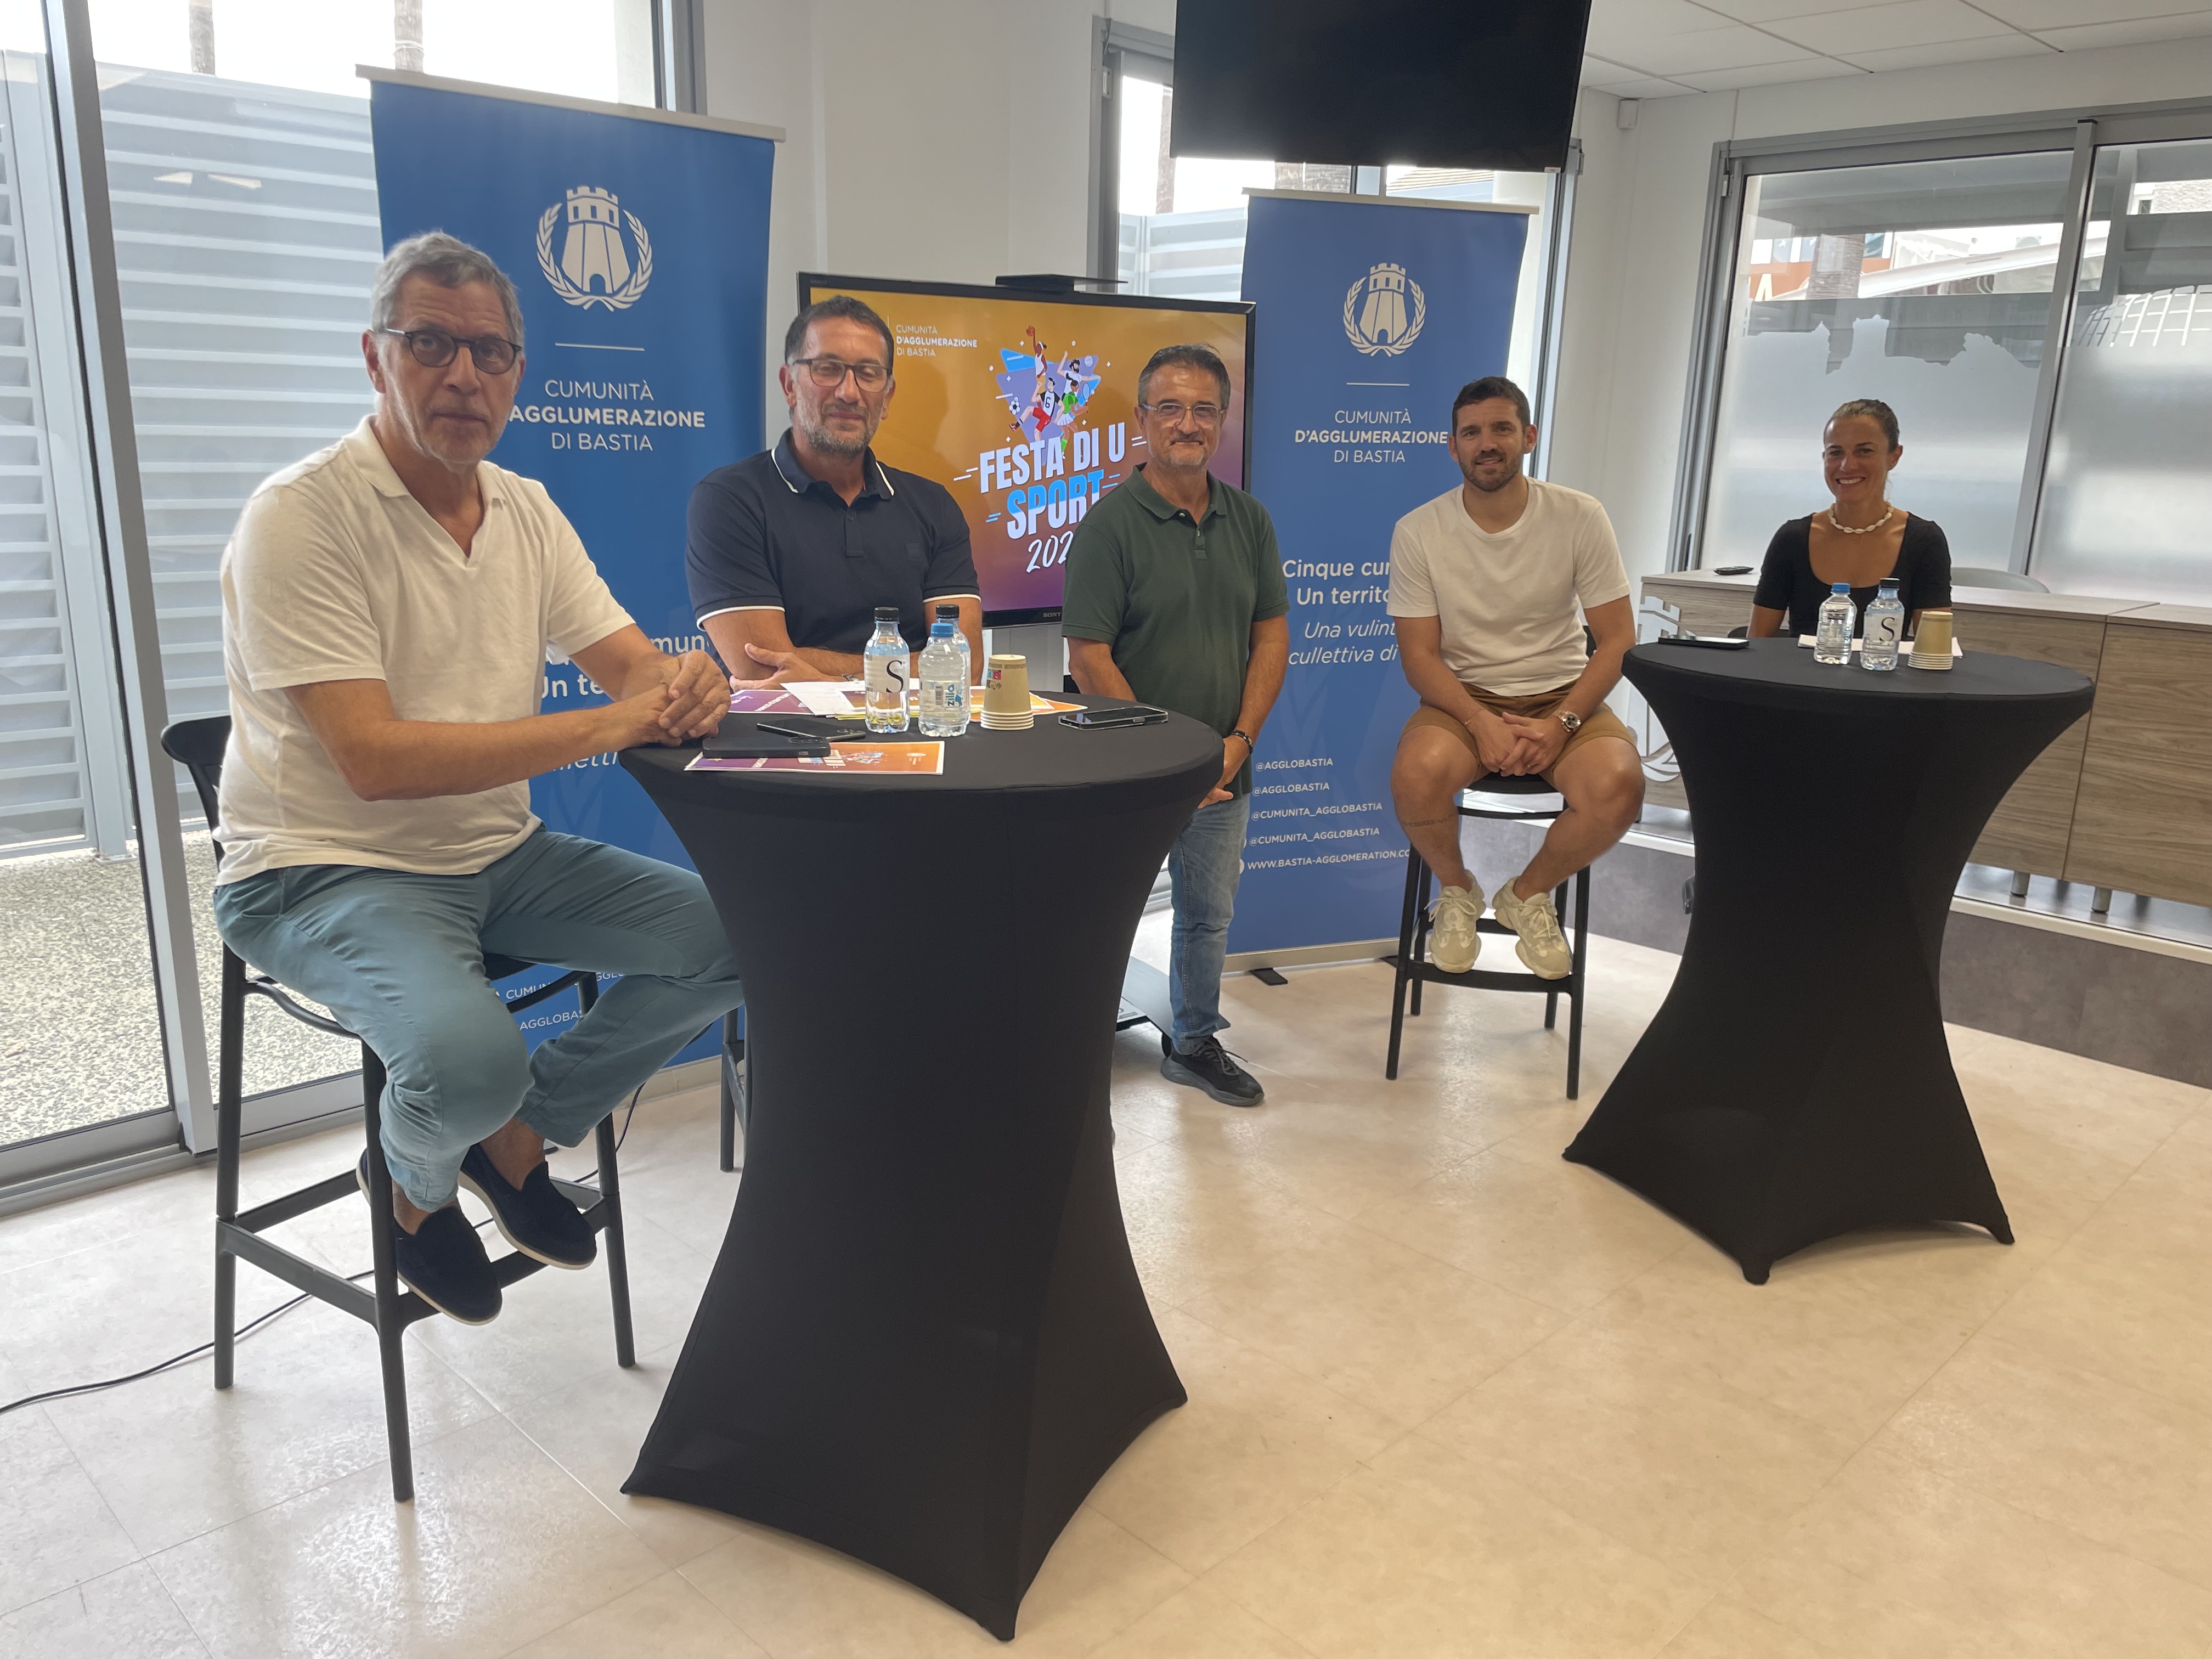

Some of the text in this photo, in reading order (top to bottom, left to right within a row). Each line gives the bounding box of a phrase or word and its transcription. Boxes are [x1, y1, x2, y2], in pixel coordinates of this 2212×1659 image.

[895, 324, 938, 335] CUMUNITÀ
[896, 347, 936, 357] DI BASTIA
[544, 380, 654, 401] CUMUNITÀ
[1045, 396, 1051, 408] 6
[509, 405, 706, 428] AGGLUMERAZIONE
[1334, 408, 1412, 424] CUMUNITÀ
[551, 432, 653, 452] DI BASTIA
[980, 421, 1125, 494] FESTA DI U
[1334, 450, 1406, 463] DI BASTIA
[1006, 469, 1104, 540] SPORT
[1026, 530, 1074, 574] 202
[1282, 559, 1355, 580] Cinque
[1297, 587, 1324, 605] Un
[1305, 619, 1396, 639] Una vulint
[1880, 617, 1895, 642] S
[1288, 644, 1399, 665] cullettiva di
[1256, 758, 1334, 772] @AGGLOBASTIA
[1252, 782, 1330, 797] @AGGLOBASTIA
[1251, 803, 1383, 821] @CUMUNITA_AGGLOBASTIA
[1249, 827, 1380, 847] @CUMUNITA_AGGLOBASTIA
